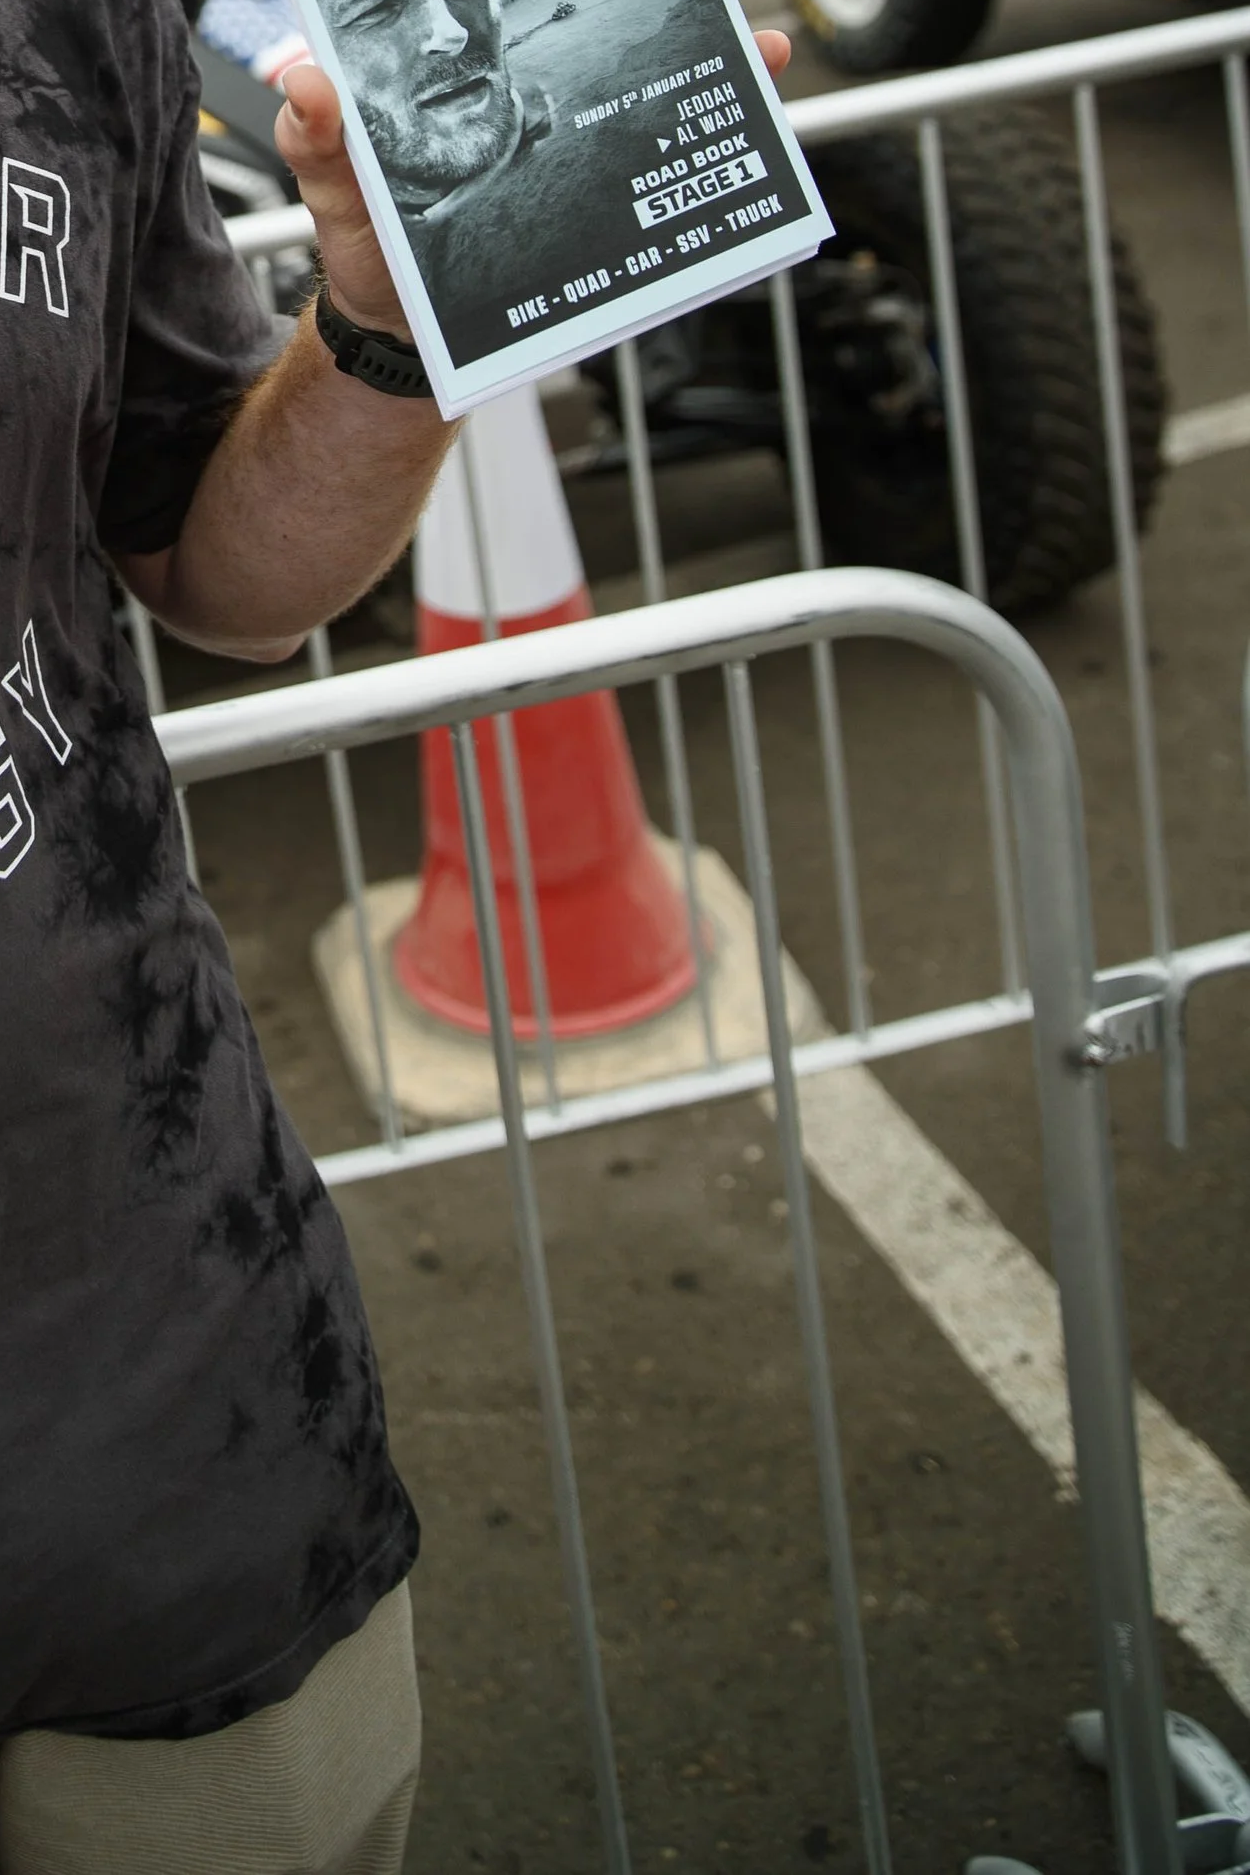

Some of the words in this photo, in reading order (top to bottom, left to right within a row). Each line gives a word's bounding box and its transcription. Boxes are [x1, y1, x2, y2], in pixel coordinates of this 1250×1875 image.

[574, 99, 620, 129] SUNDAY
[622, 91, 638, 109] 5th
[641, 69, 691, 102] JANUARY
[693, 56, 724, 80] 2020
[676, 81, 737, 121] JEDDAH
[676, 125, 699, 145] AL
[698, 102, 745, 135] WAJH
[630, 158, 689, 195] ROAD
[691, 132, 749, 168] BOOK
[647, 168, 735, 220] STAGE
[734, 159, 754, 183] 1
[506, 295, 550, 328] BIKE
[563, 268, 611, 303] QUAD
[625, 246, 663, 276] CAR
[675, 224, 711, 254] SSV
[724, 193, 784, 232] TRUCK
